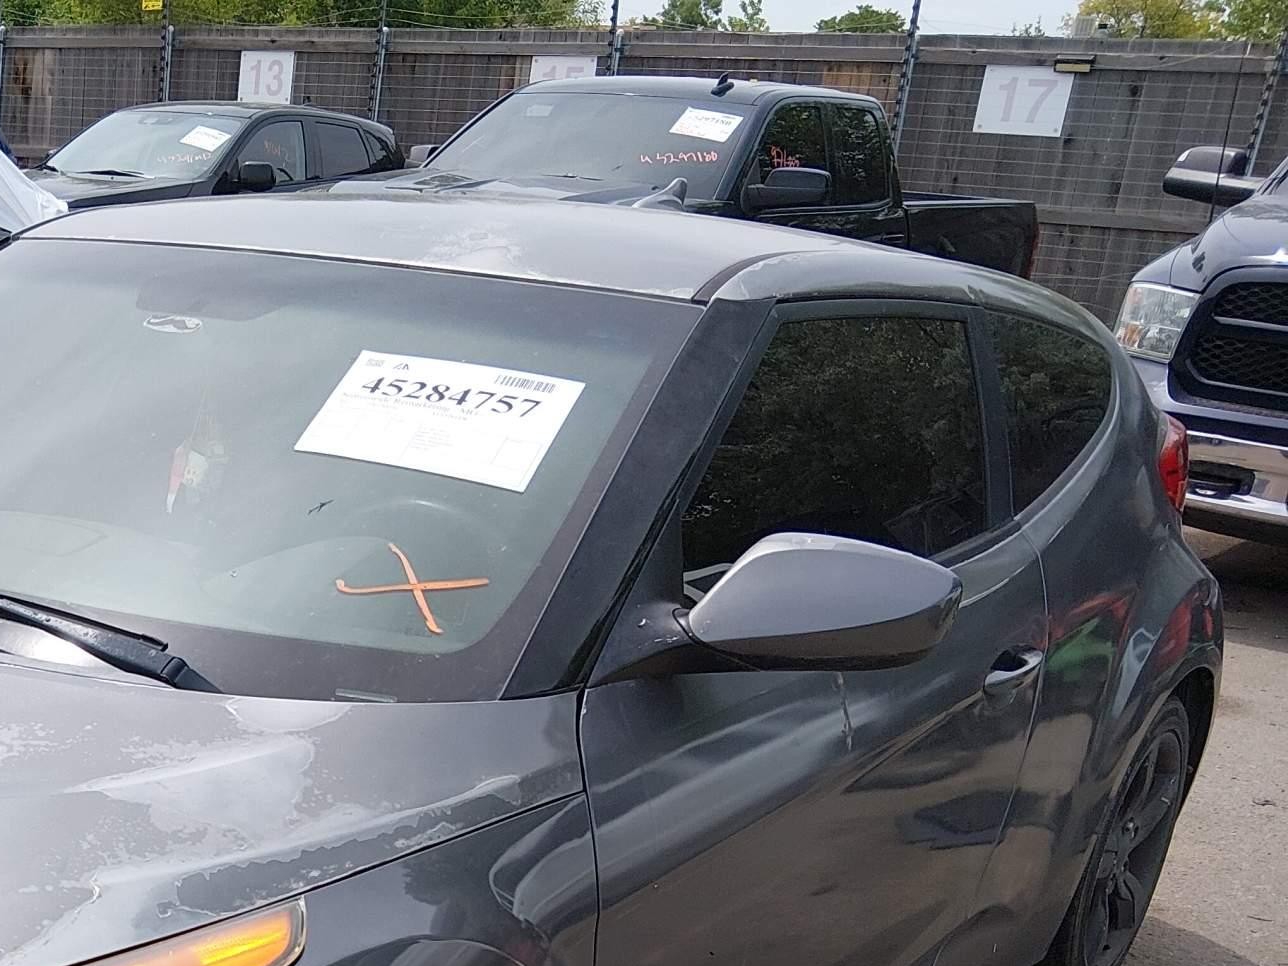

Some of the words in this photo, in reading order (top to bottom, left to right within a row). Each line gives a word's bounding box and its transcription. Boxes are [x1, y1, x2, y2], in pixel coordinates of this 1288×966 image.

[250, 59, 284, 97] 13
[999, 76, 1059, 123] 17
[361, 376, 543, 418] 45284757
